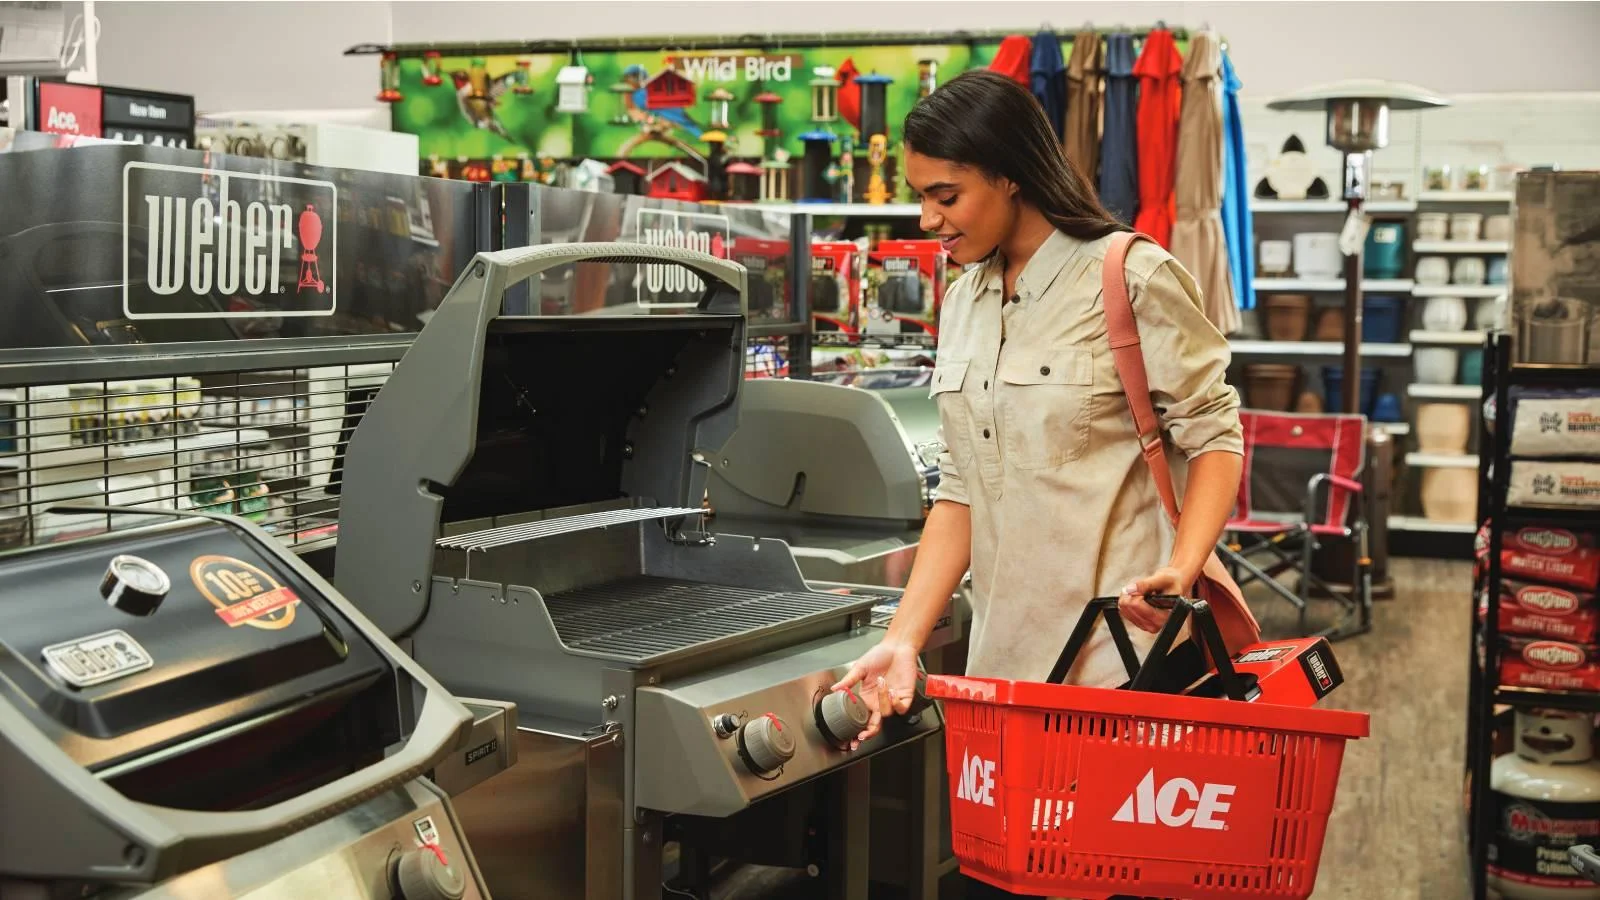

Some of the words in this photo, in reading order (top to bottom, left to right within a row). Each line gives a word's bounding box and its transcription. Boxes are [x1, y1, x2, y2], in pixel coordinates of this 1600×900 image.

[683, 55, 737, 81] Wild
[745, 55, 791, 81] Bird
[48, 106, 79, 132] Ace,
[130, 102, 147, 117] New
[149, 105, 167, 119] Item
[145, 174, 293, 295] weber
[204, 568, 253, 600] 10
[1309, 653, 1327, 681] weber
[467, 744, 490, 762] SPIRIT
[957, 746, 996, 807] ACE
[1111, 767, 1237, 831] ACE
